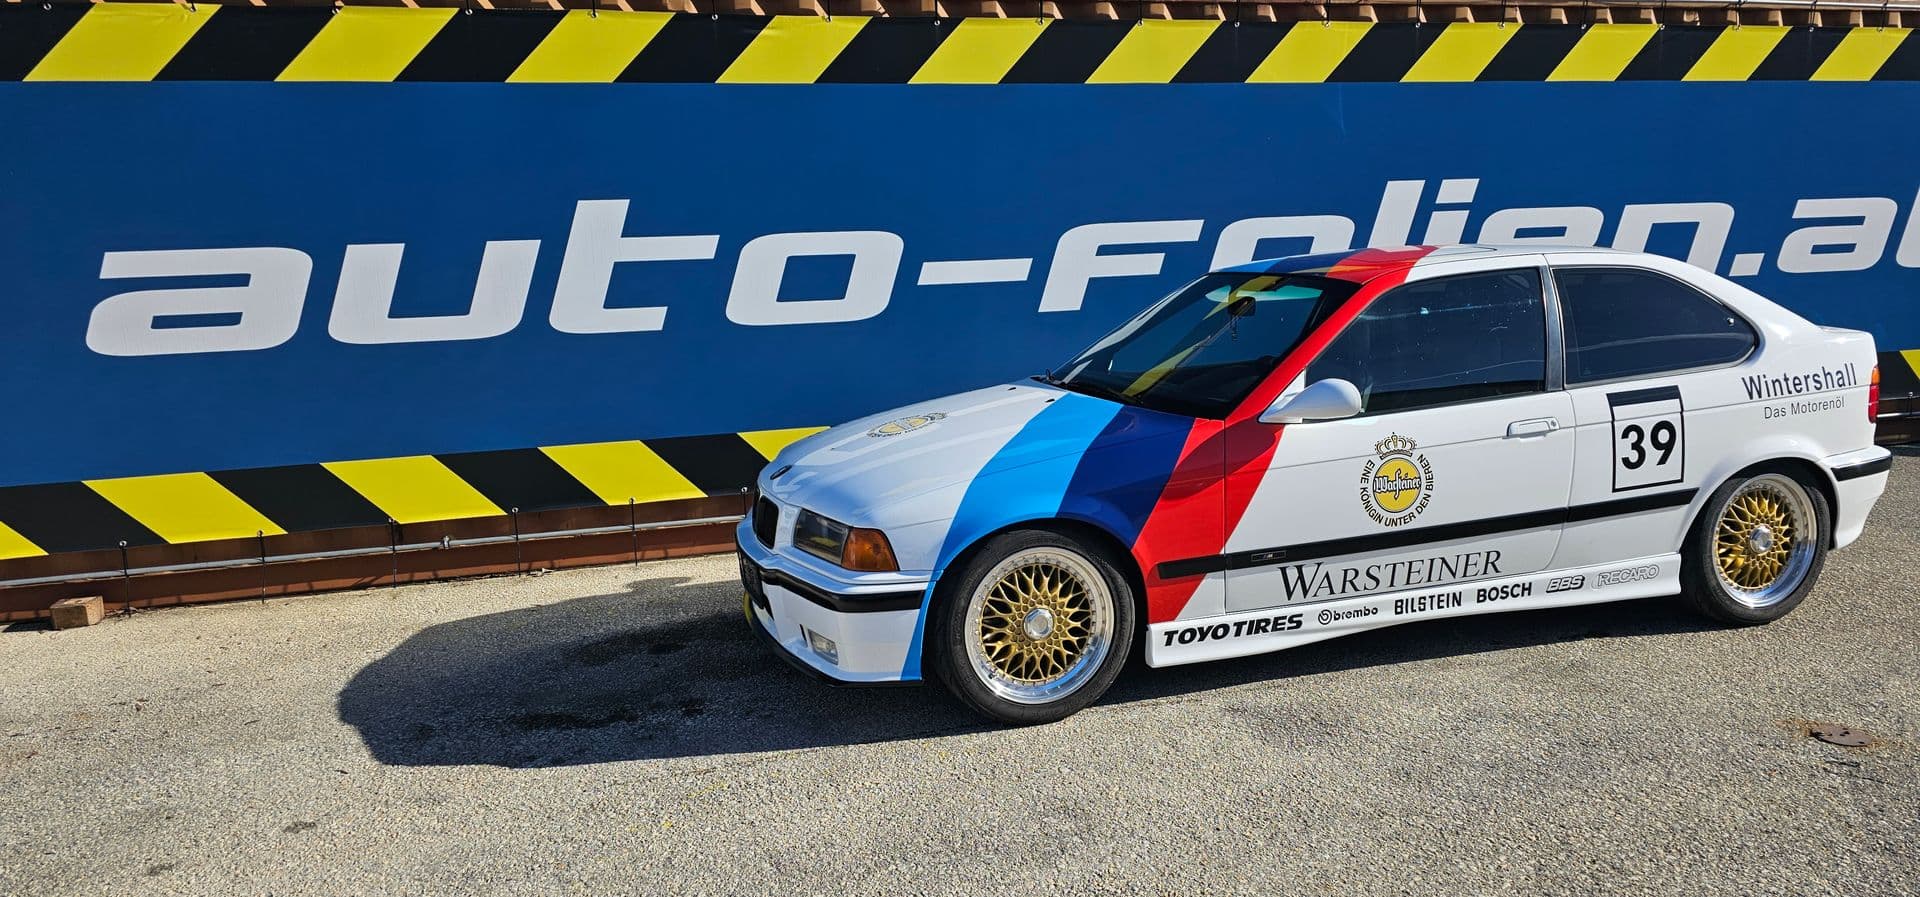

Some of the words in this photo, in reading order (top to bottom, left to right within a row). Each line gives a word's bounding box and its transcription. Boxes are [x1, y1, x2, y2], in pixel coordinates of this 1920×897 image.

[86, 178, 1920, 357] auto-folien.a
[1742, 362, 1857, 400] Wintershall
[1764, 406, 1787, 419] Das
[1791, 396, 1845, 416] Motorenöl
[1621, 420, 1677, 469] 39
[1360, 459, 1376, 484] EINE
[1417, 453, 1434, 491] BIEREN
[1360, 486, 1384, 524] KÖNIGIN
[1415, 493, 1432, 514] DEN
[1384, 512, 1417, 527] UNTER
[1546, 575, 1585, 593] BBS
[1595, 565, 1660, 589] RECARO
[1394, 591, 1463, 615] BILSTEIN
[1476, 582, 1533, 604] BOSCH
[1332, 607, 1379, 622] brembo
